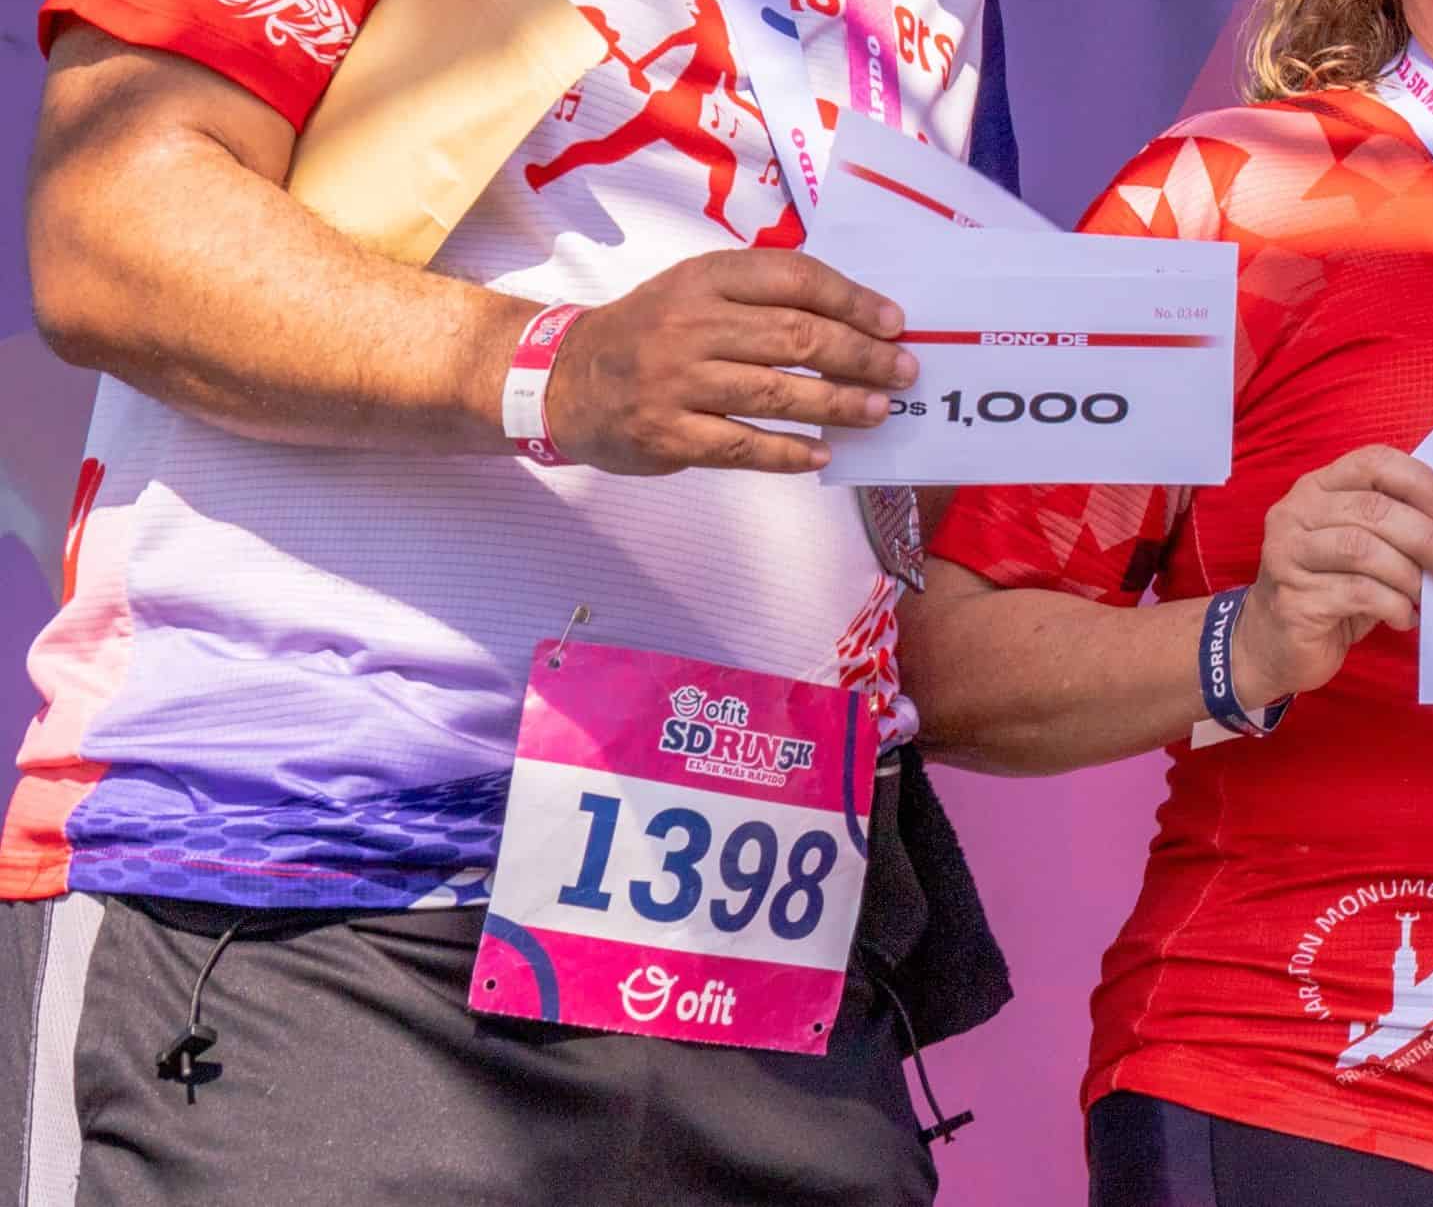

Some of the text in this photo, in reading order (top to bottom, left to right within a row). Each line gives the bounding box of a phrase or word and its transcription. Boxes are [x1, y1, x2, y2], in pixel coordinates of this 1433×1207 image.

[1407, 71, 1429, 98] 5K
[1154, 307, 1174, 320] No.
[979, 333, 1088, 346] BONO DE
[888, 391, 1129, 426] D$ 1,000
[1209, 600, 1235, 698] CORRAL C
[704, 698, 748, 725] ofit
[661, 719, 814, 770] SDRUN5K
[722, 763, 747, 778] MÁS
[748, 768, 785, 786] RÁPIDO
[557, 790, 838, 941] 1398
[675, 978, 737, 1025] ofit
